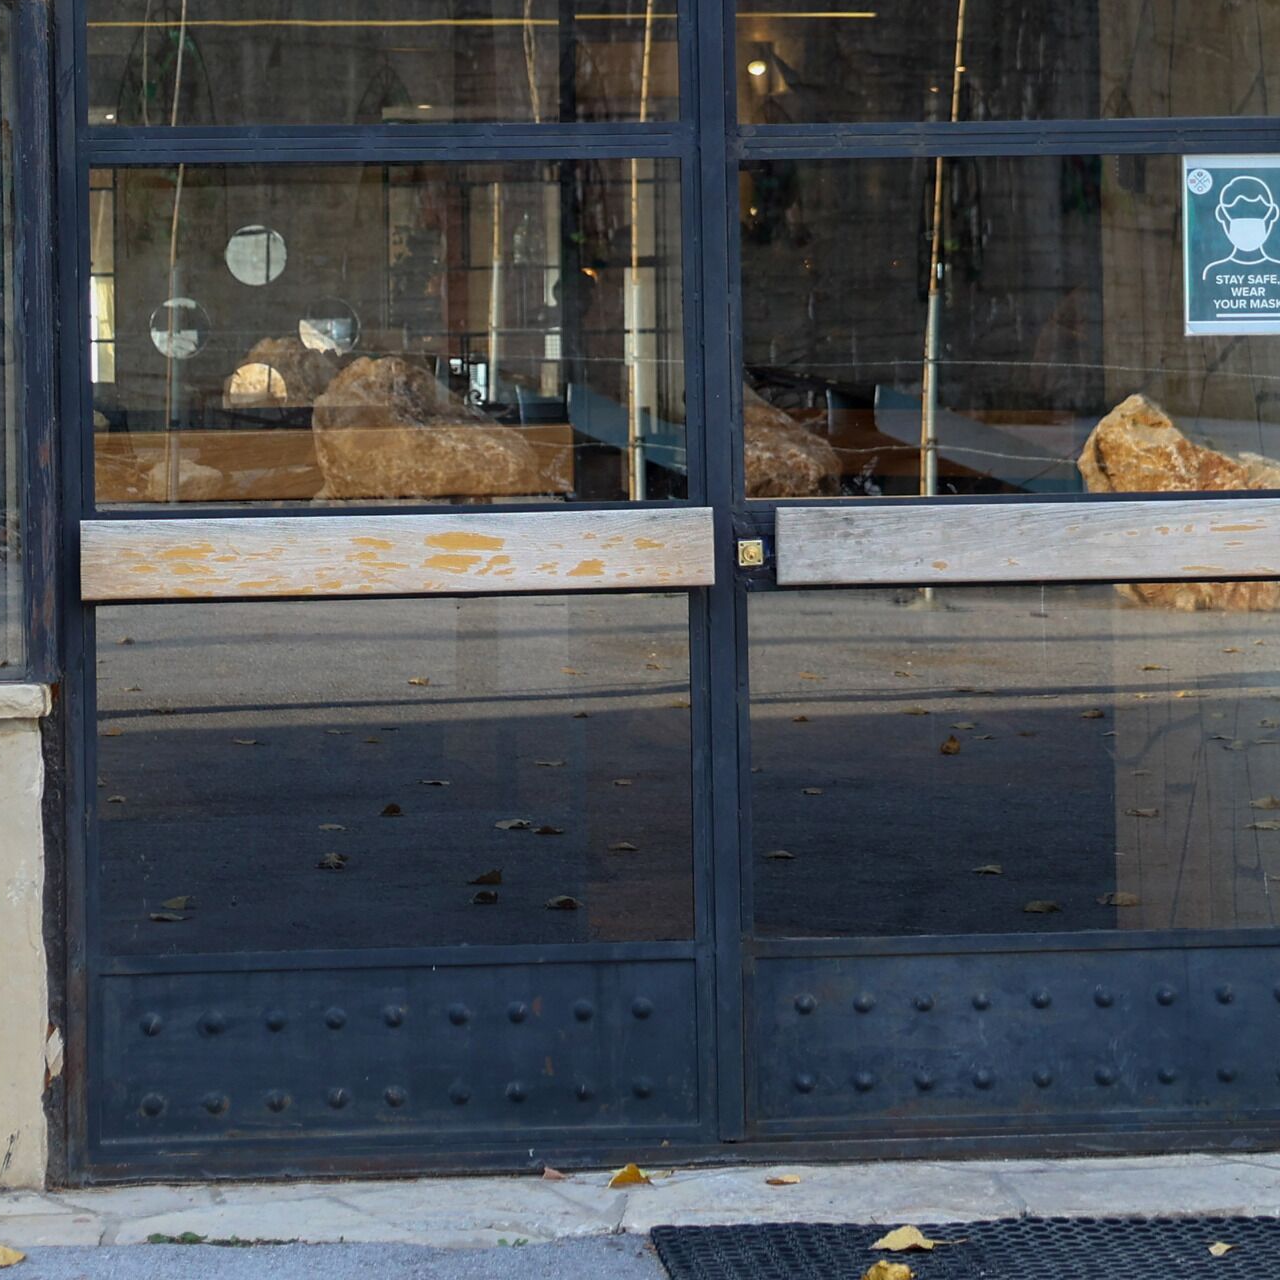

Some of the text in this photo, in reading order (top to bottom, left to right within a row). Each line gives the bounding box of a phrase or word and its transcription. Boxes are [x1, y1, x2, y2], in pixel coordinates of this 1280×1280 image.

[1215, 274, 1280, 285] STAY SAFE,
[1230, 286, 1266, 297] WEAR
[1213, 298, 1247, 309] YOUR
